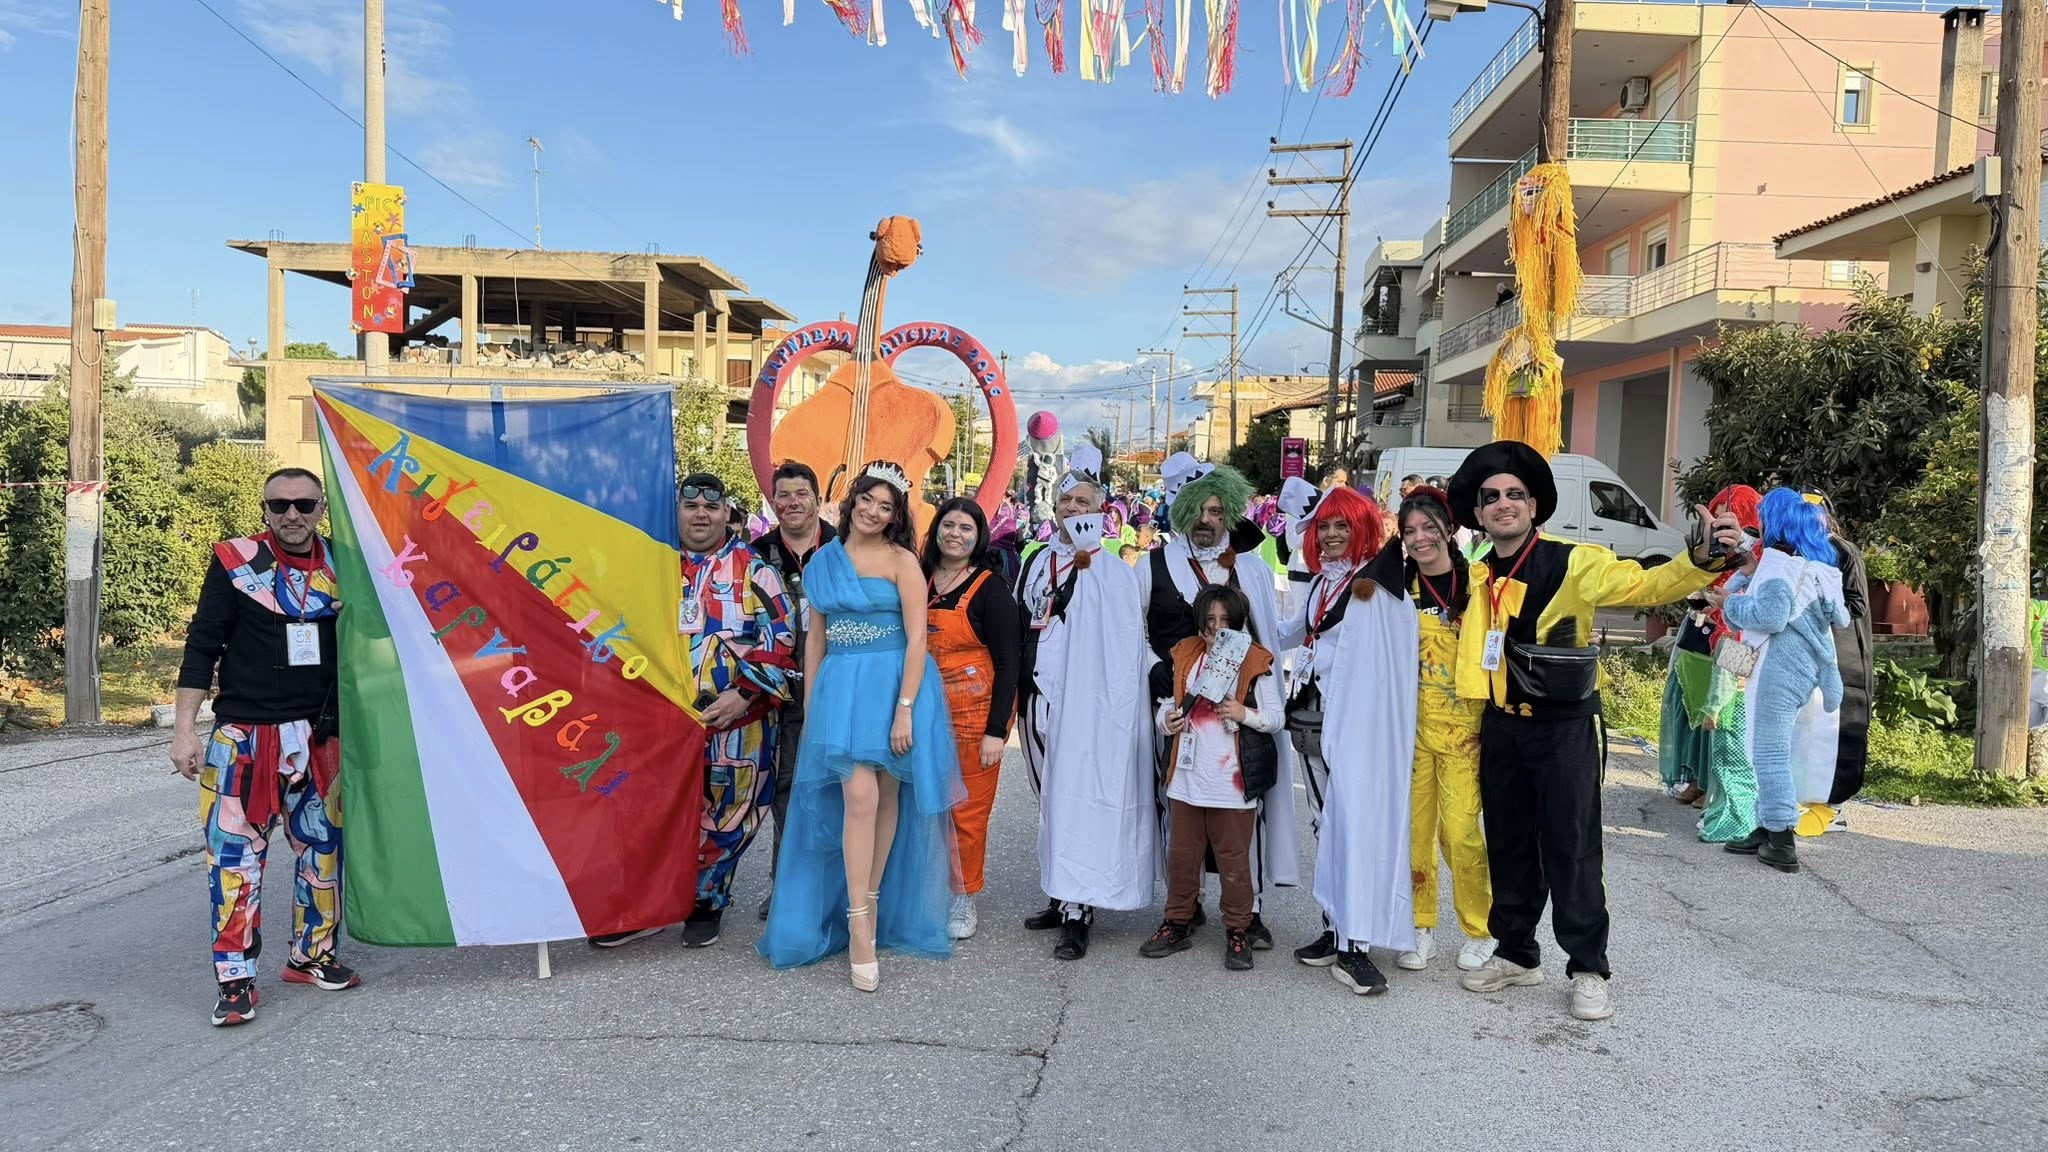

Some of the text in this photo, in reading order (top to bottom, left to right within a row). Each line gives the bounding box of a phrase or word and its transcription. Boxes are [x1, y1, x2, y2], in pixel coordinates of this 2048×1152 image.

[364, 195, 392, 213] PIC
[760, 328, 853, 388] ΚΑΡΝΑΒΑΛ
[967, 347, 1003, 397] 2026
[366, 430, 650, 681] Αιγειράτικο
